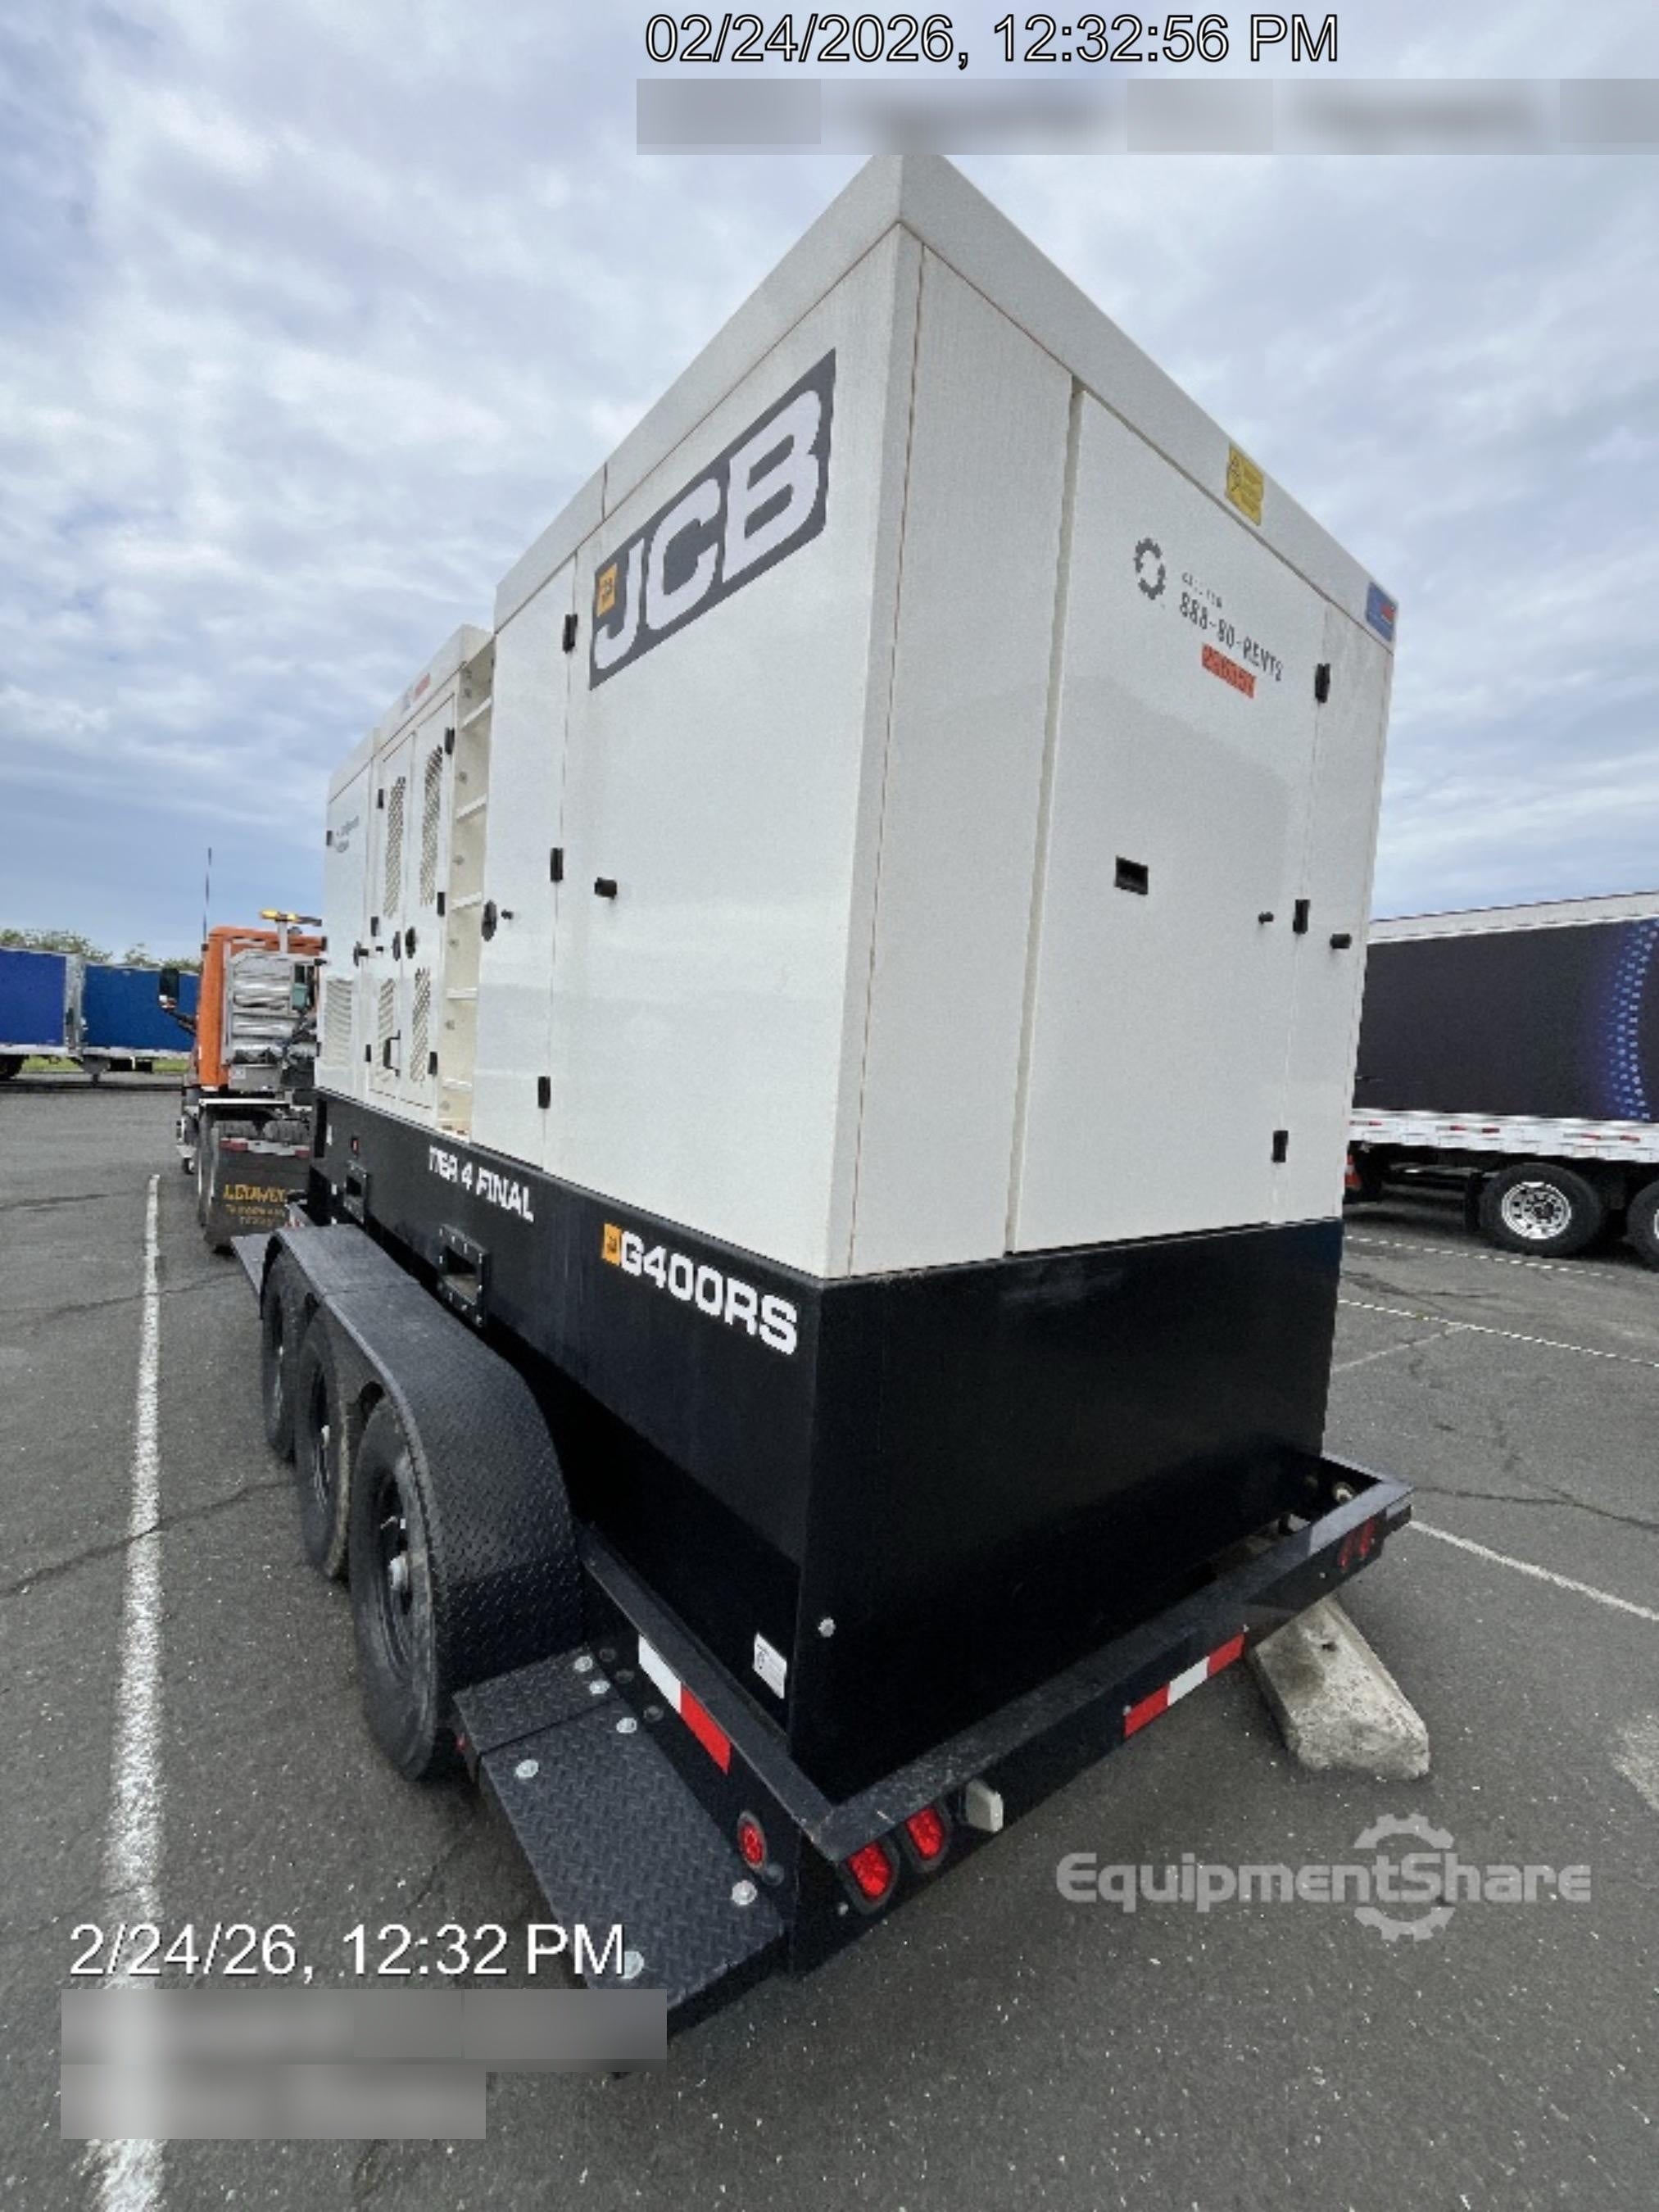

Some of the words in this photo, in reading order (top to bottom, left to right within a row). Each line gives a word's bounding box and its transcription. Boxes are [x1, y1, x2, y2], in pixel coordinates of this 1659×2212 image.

[593, 389, 821, 670] JCB
[461, 1162, 474, 1190] 4
[476, 1166, 534, 1222] FINAL
[620, 1230, 798, 1355] G400RS
